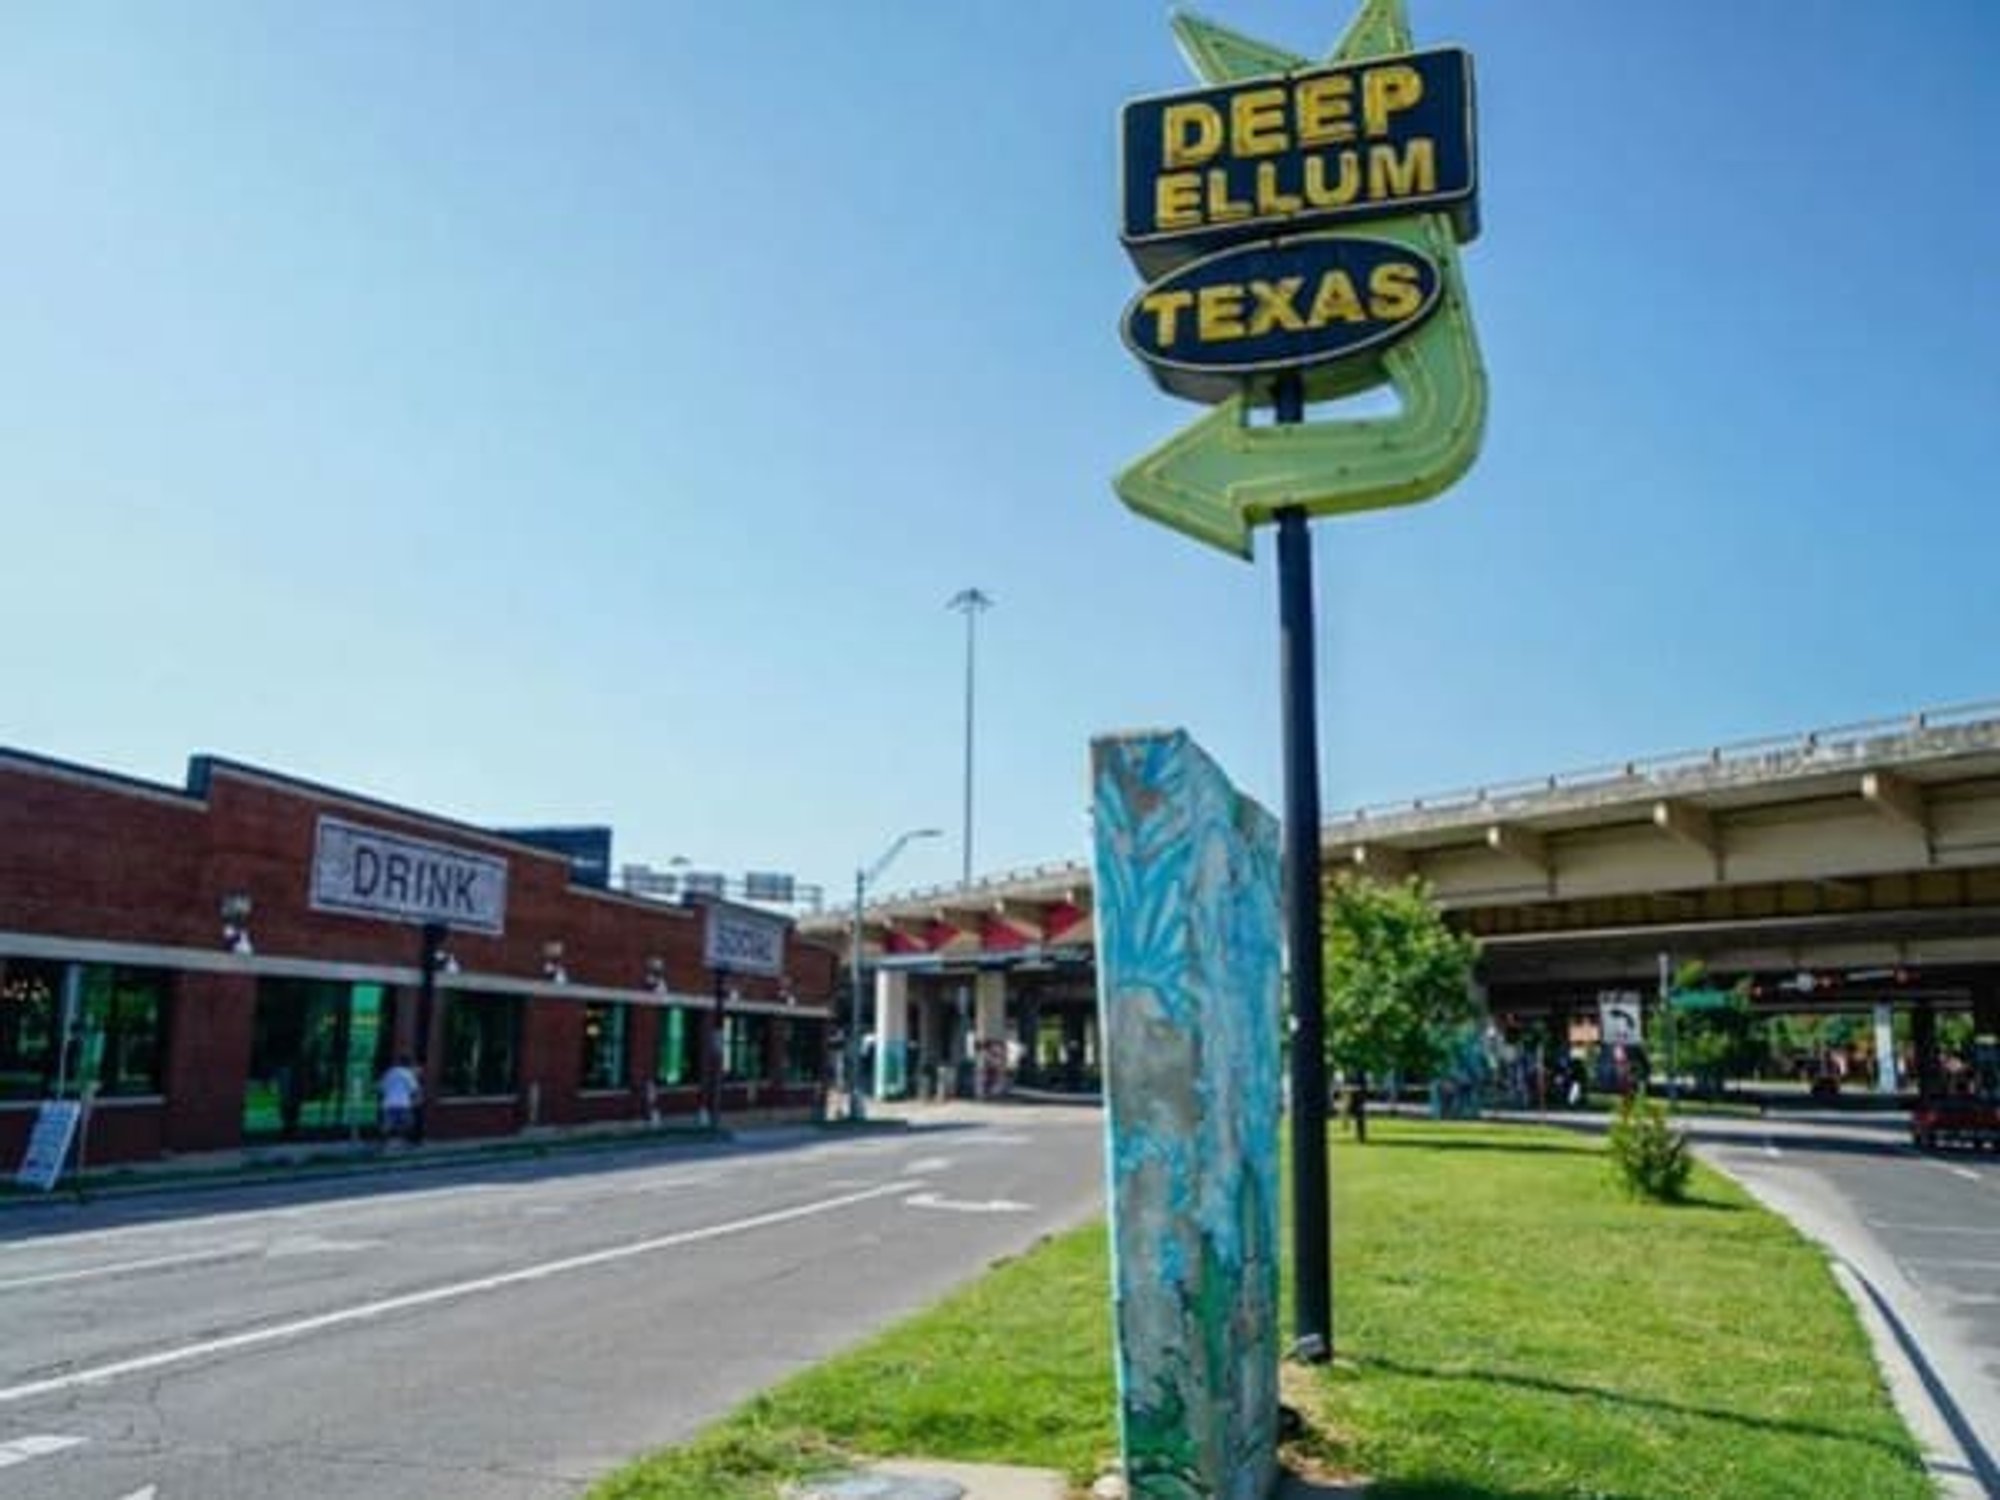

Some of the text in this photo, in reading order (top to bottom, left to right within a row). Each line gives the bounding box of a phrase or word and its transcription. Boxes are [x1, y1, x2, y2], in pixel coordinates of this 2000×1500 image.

[1162, 65, 1423, 167] DEEP
[1155, 137, 1436, 229] ELLUM
[1141, 262, 1423, 347] TEXAS
[352, 846, 478, 913] DRINK
